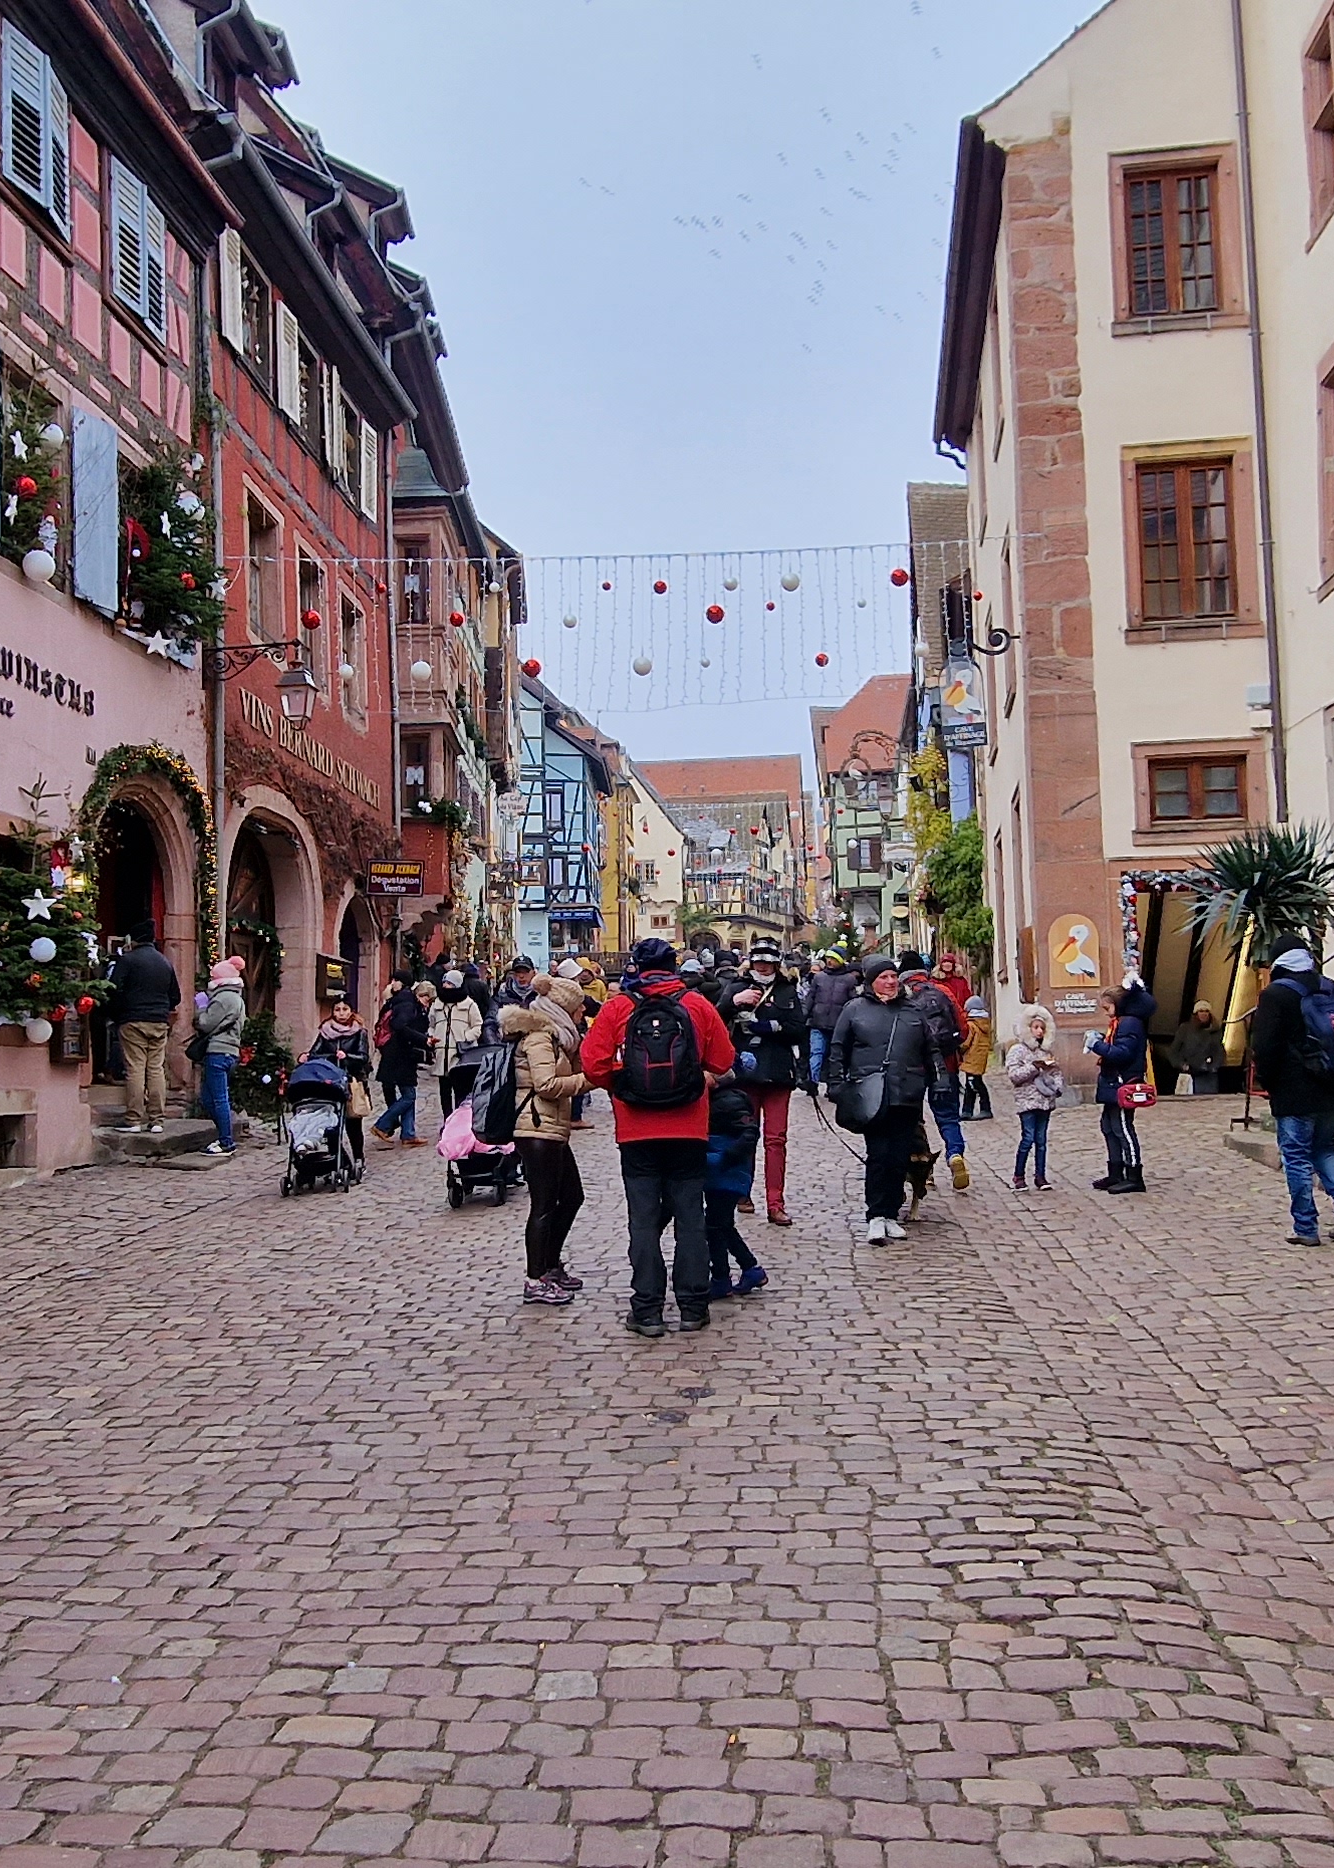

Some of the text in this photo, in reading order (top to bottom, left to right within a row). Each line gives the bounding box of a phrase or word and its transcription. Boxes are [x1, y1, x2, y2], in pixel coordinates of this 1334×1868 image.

[239, 687, 380, 810] VINS BERNARD SCHWACH
